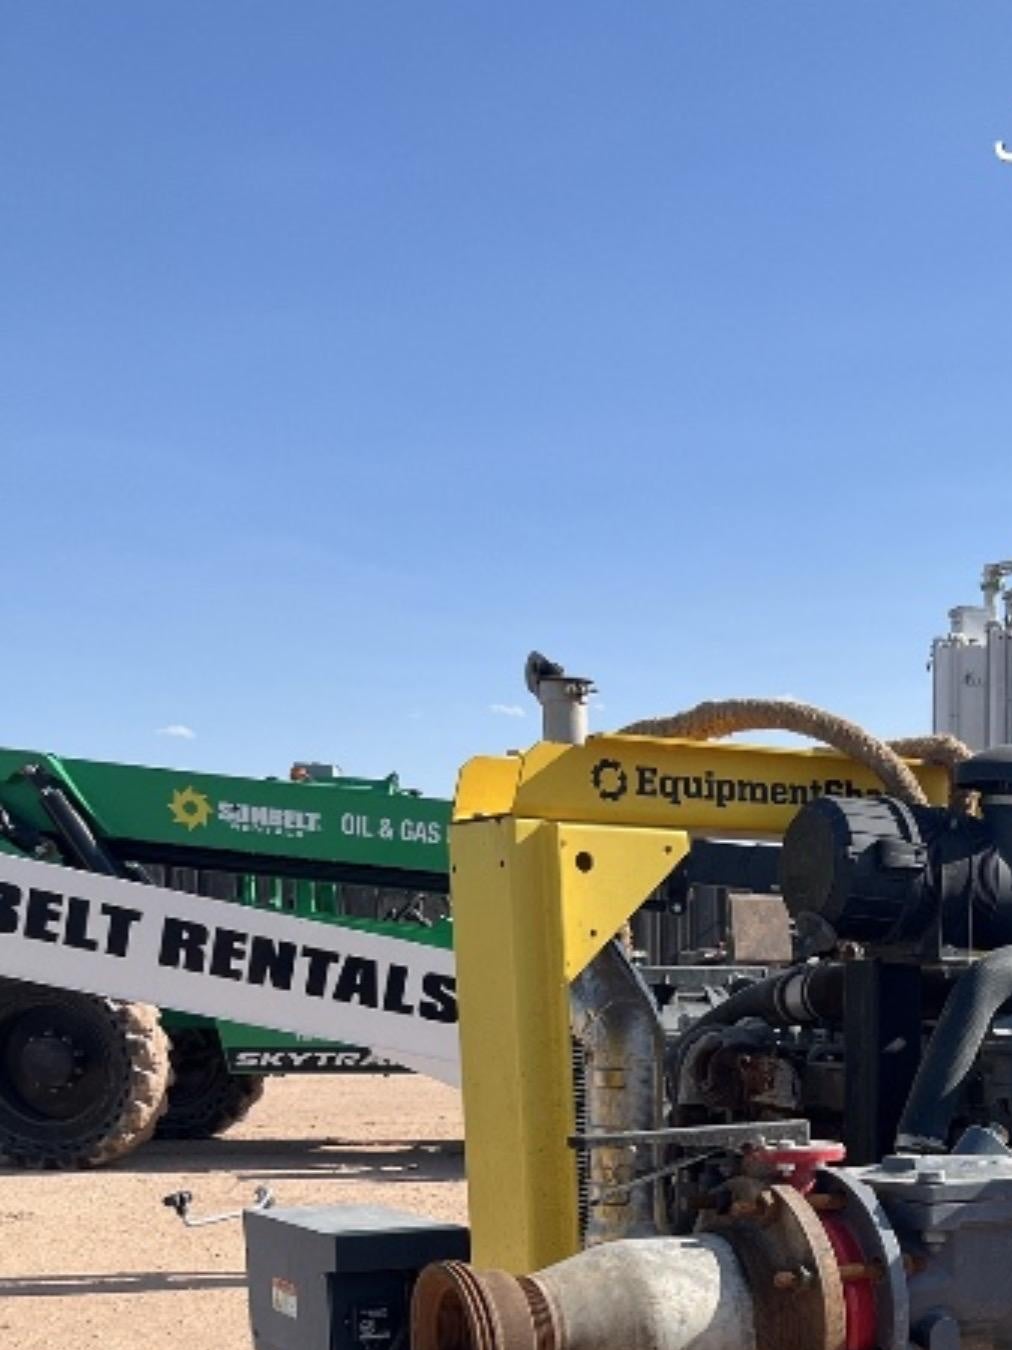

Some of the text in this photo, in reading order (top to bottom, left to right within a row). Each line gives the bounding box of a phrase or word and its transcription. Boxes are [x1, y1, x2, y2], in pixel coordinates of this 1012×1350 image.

[341, 812, 373, 838] OIL
[378, 817, 395, 841] &
[401, 818, 441, 845] GAS
[158, 916, 459, 1024] RENTALS
